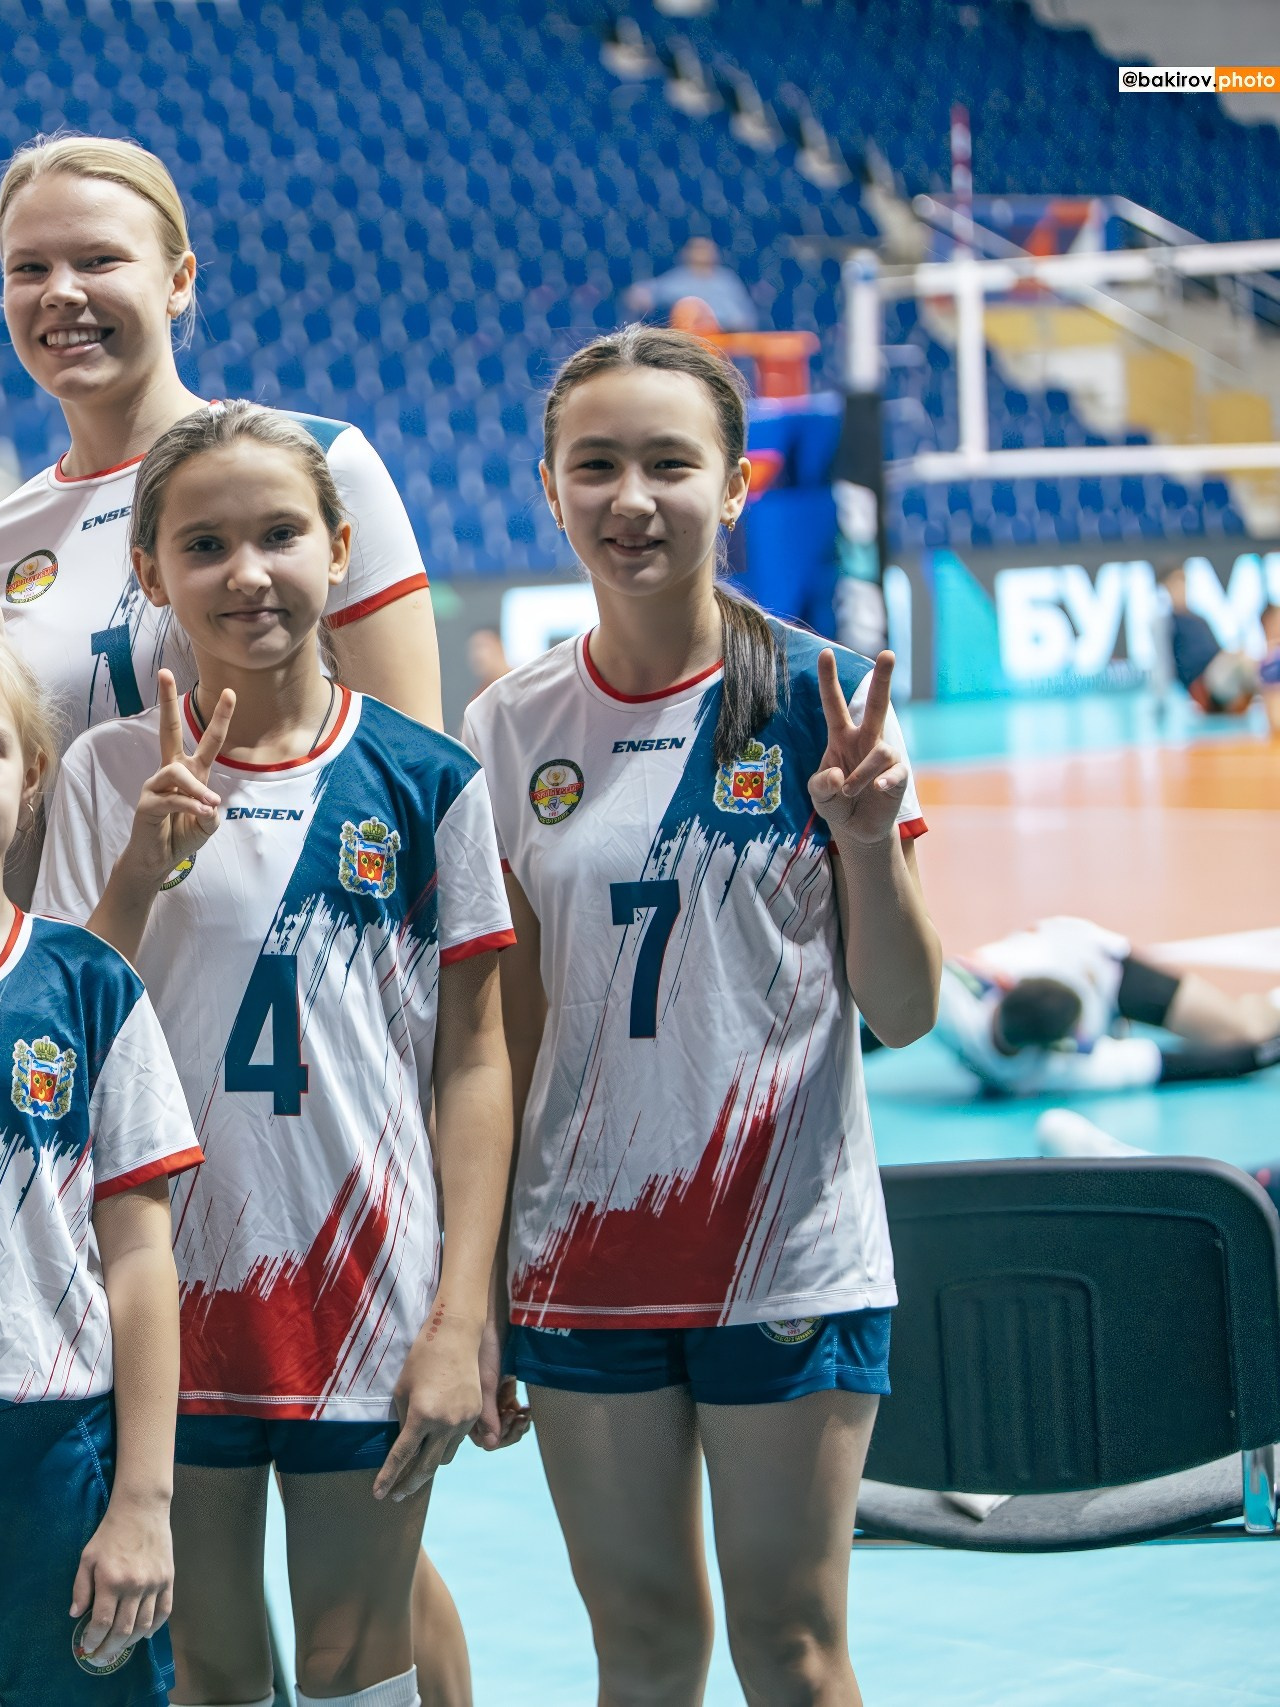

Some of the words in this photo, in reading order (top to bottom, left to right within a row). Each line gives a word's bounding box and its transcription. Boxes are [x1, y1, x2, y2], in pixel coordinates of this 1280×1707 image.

[81, 505, 132, 532] ENSE
[611, 736, 687, 754] ENSEN
[225, 807, 305, 822] ENSEN
[609, 878, 682, 1039] 7
[224, 953, 309, 1117] 4
